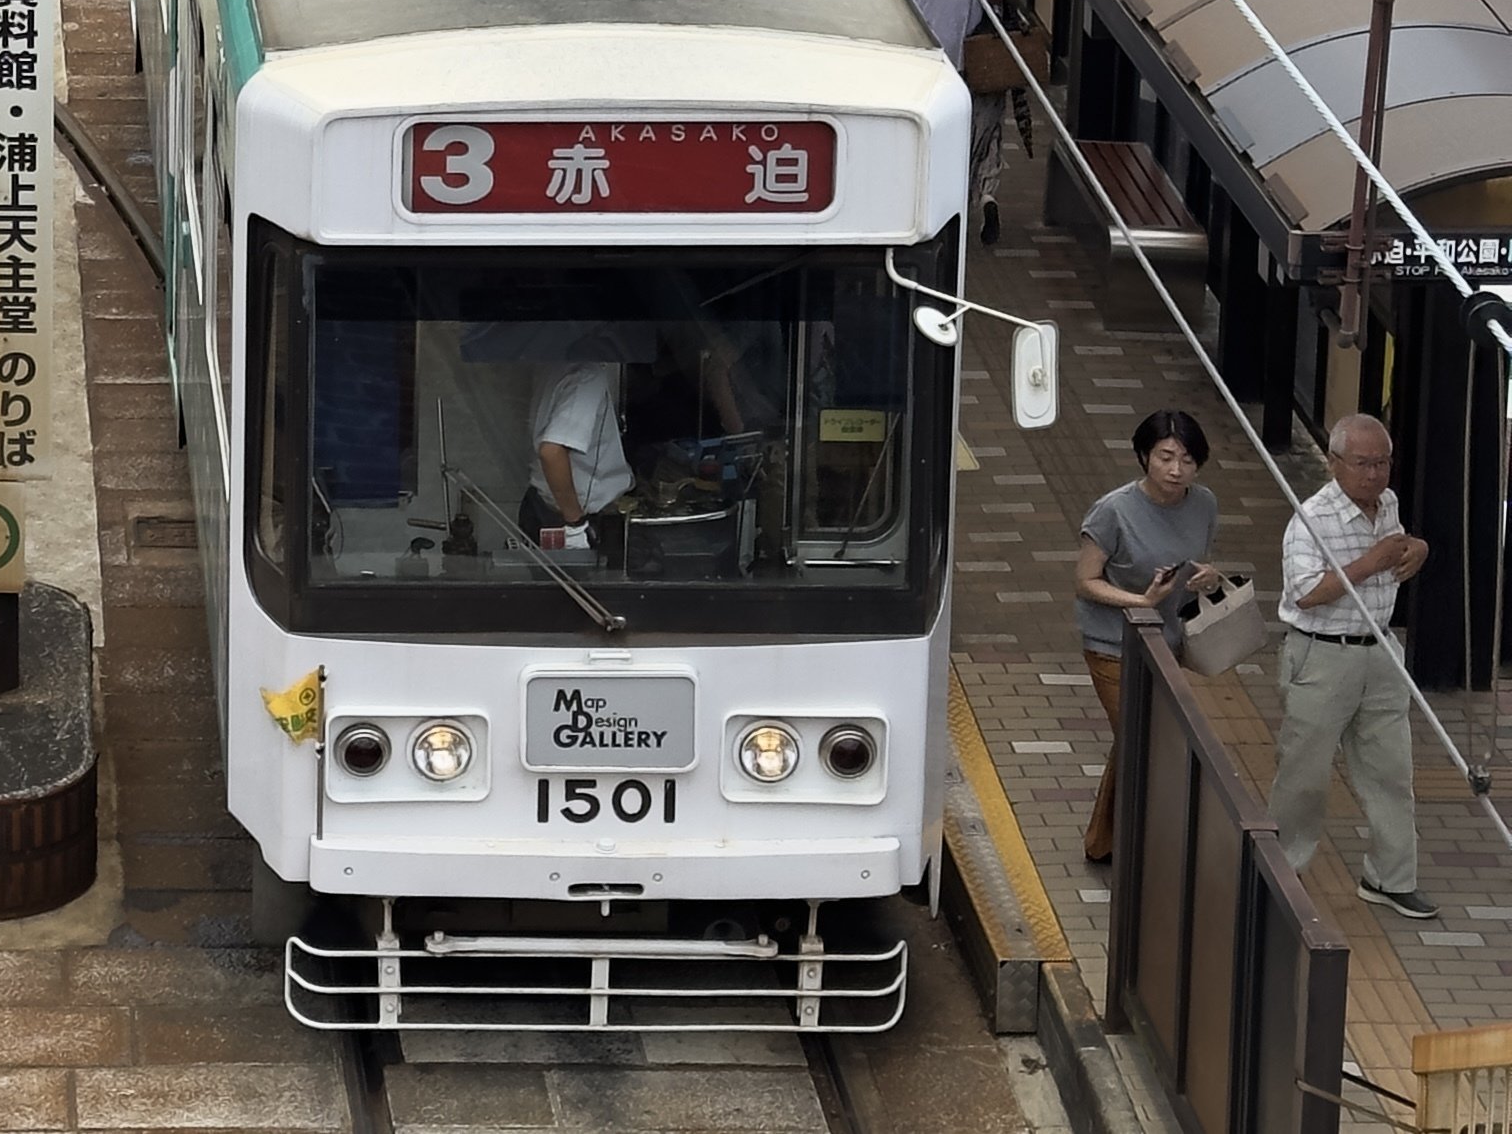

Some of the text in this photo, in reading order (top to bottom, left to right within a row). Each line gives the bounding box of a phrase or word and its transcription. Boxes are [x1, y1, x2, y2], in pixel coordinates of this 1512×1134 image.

[578, 124, 780, 142] AKASAKO
[420, 124, 495, 204] 3
[1394, 266, 1430, 276] STOP
[553, 689, 607, 713] Map
[571, 710, 638, 733] Design
[553, 724, 667, 748] GALLERY
[537, 779, 676, 823] 1501
